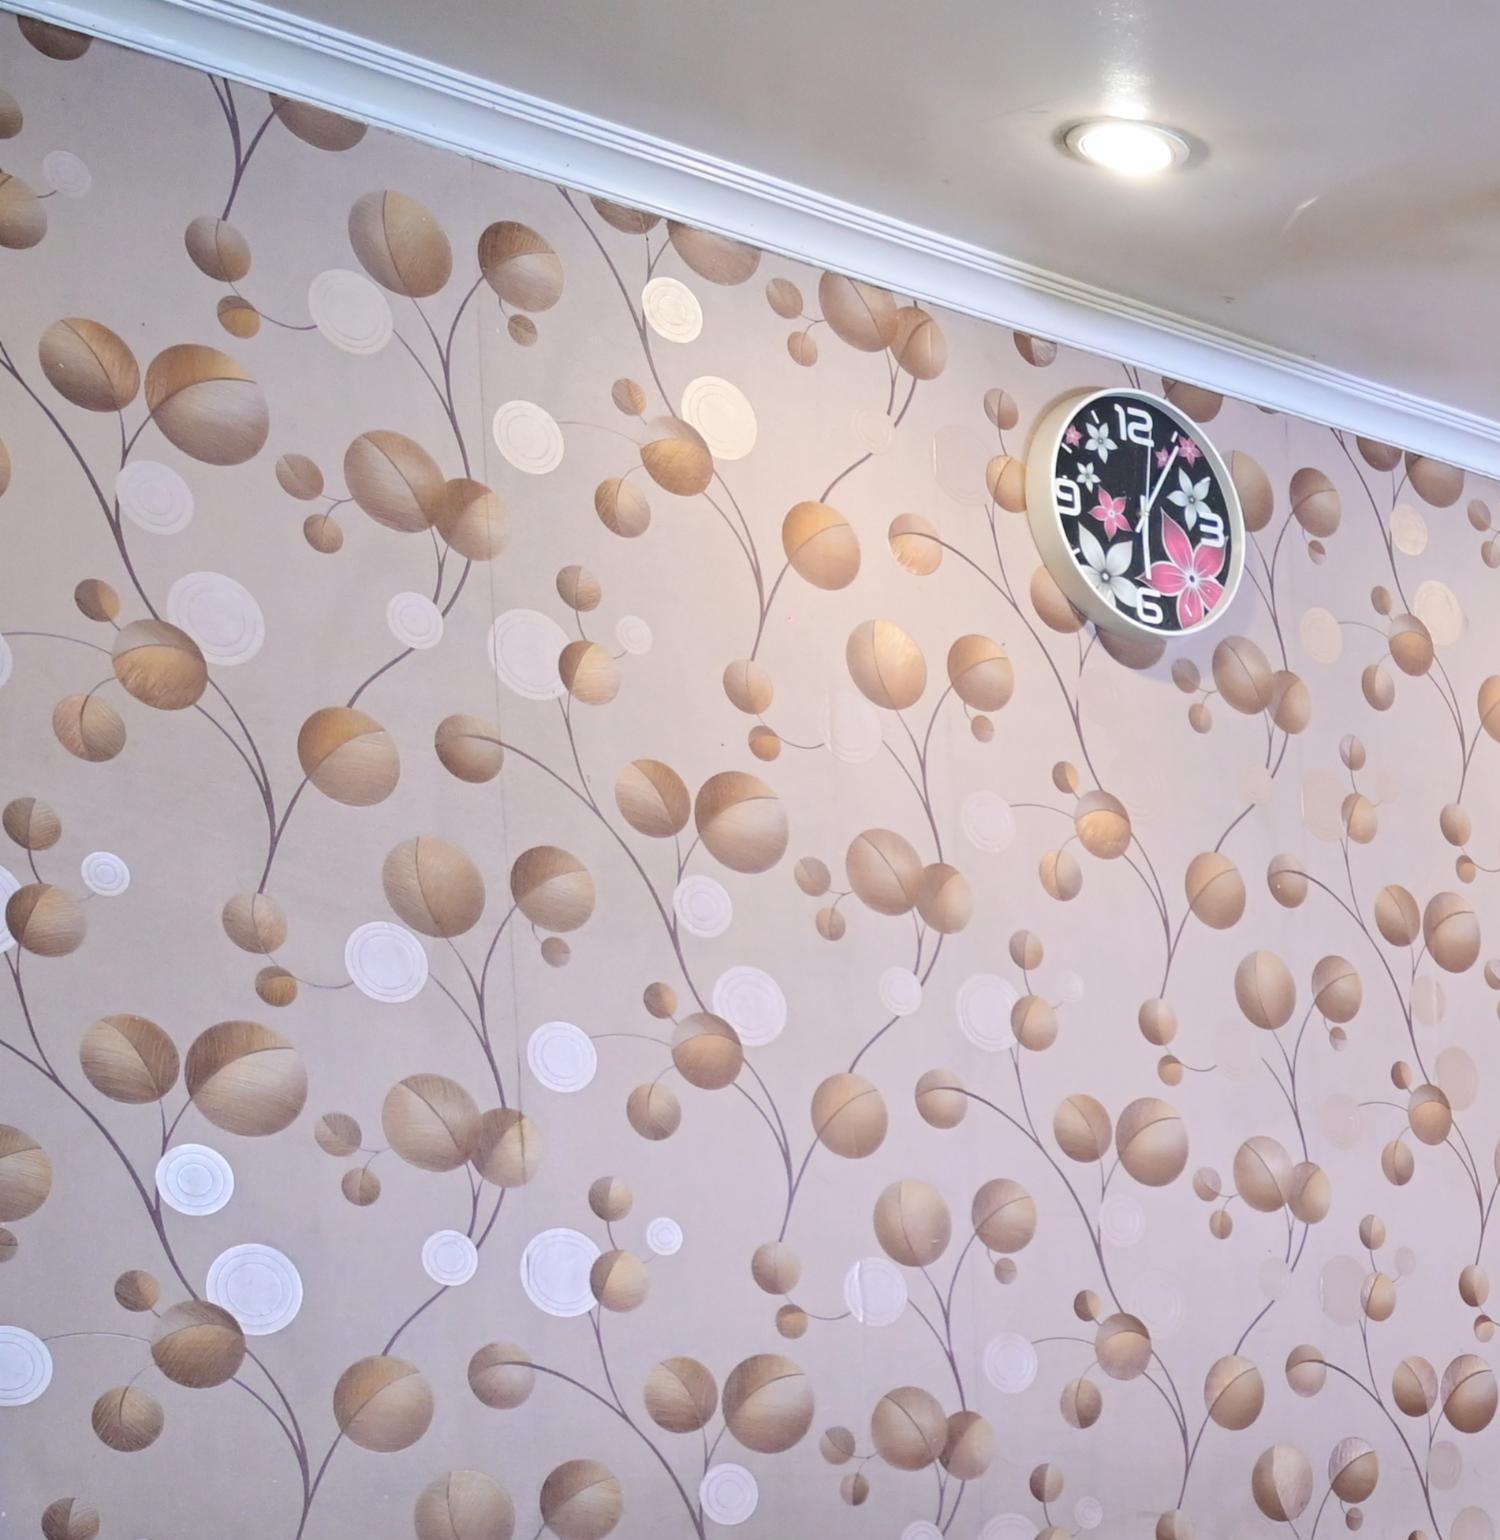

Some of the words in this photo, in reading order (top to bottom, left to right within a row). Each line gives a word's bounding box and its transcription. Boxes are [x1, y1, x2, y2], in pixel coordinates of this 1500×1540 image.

[1113, 403, 1155, 447] 12
[1055, 478, 1081, 516] 9
[1199, 512, 1225, 548] 3
[1136, 587, 1164, 625] 6
